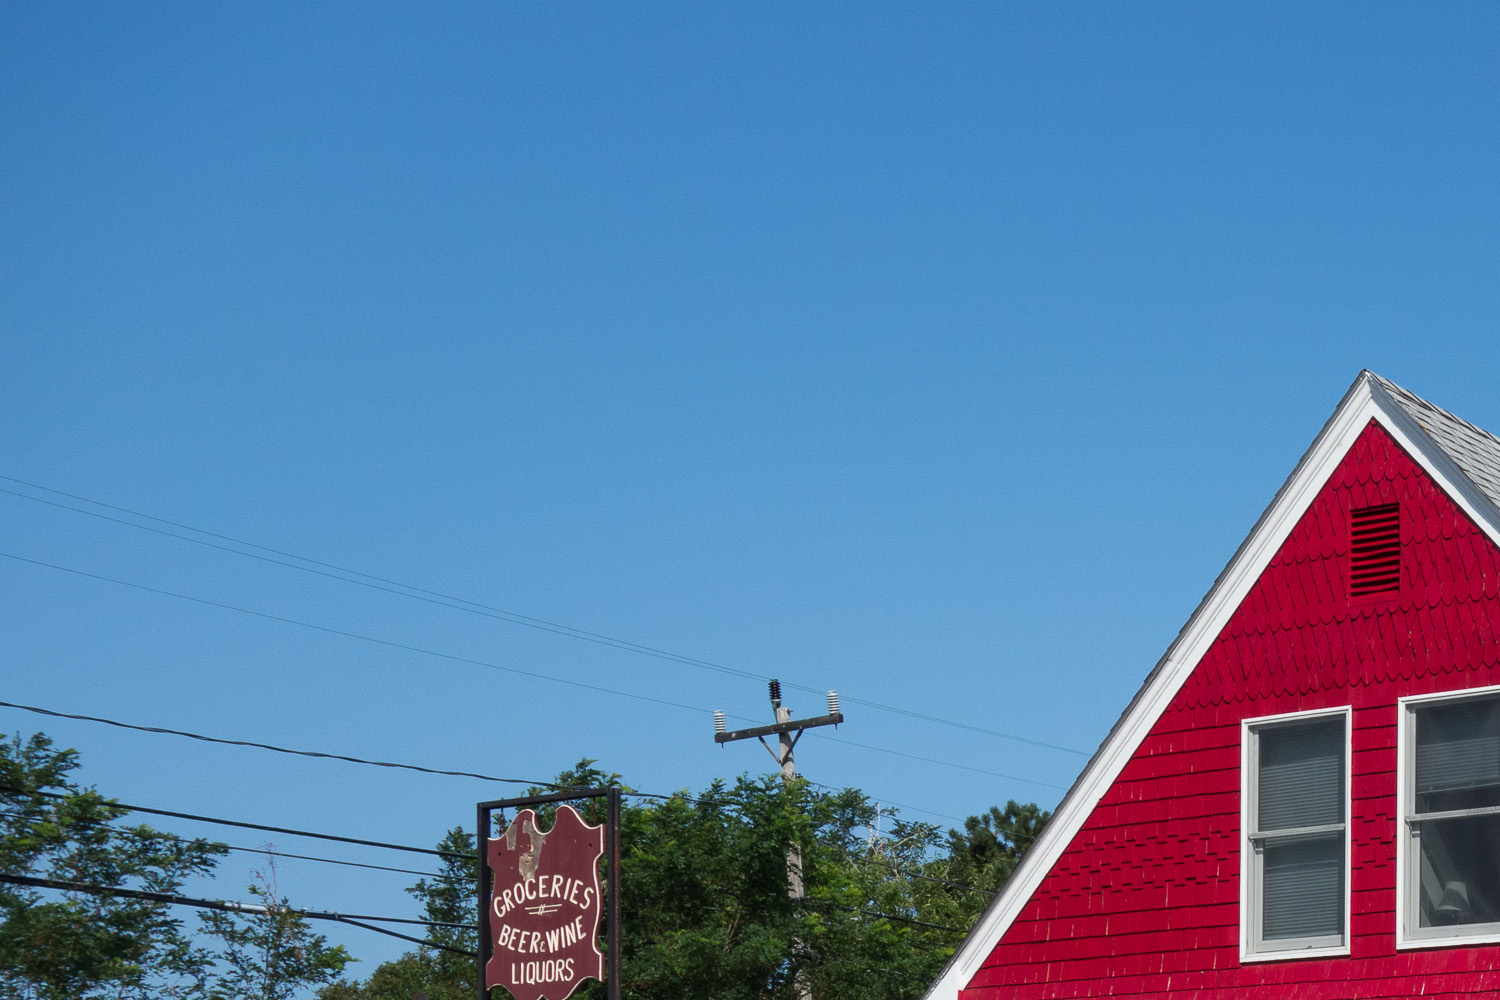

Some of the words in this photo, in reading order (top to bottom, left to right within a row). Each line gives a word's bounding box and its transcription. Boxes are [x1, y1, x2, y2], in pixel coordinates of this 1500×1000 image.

[493, 874, 594, 918] GROCERIES
[498, 924, 541, 953] BEER
[545, 915, 587, 953] WINE
[511, 958, 575, 985] LIQUORS
